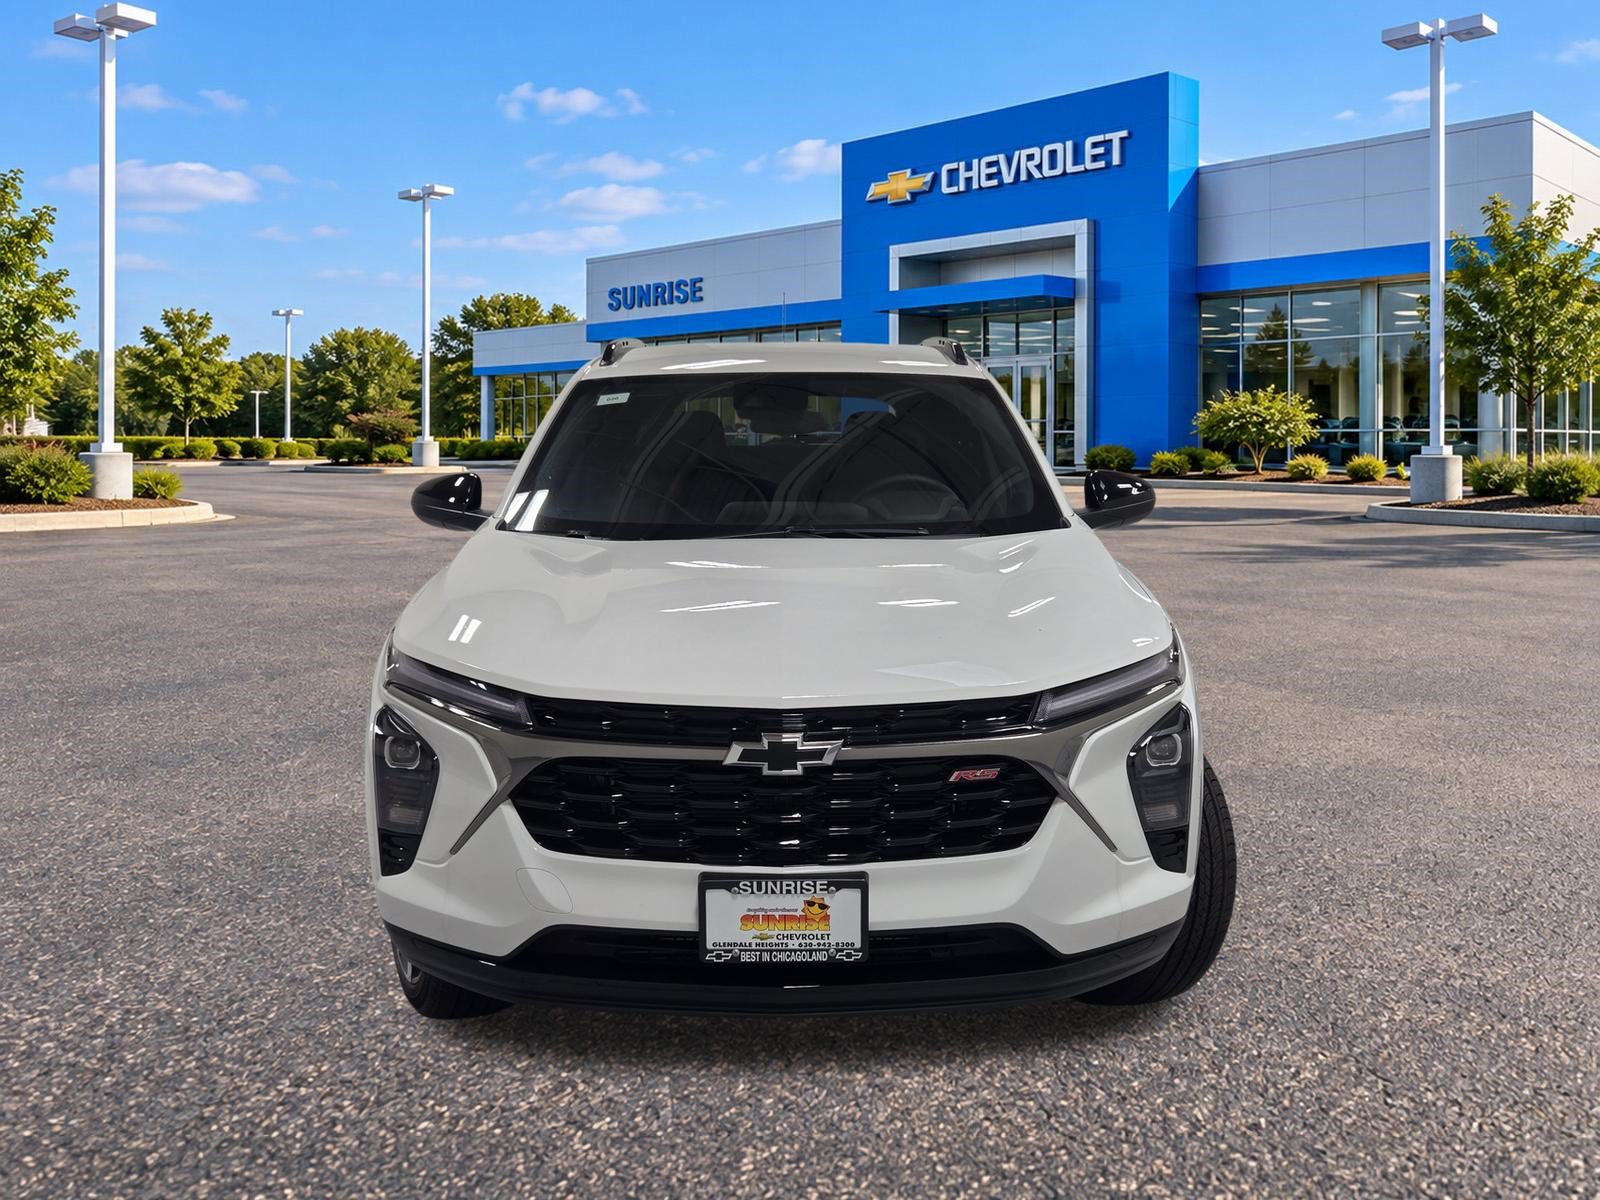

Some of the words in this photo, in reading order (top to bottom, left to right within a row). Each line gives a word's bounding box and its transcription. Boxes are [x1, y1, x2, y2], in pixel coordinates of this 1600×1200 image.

[940, 129, 1129, 194] CHEVROLET
[608, 277, 704, 312] SUNRISE
[949, 767, 1000, 782] RS
[739, 881, 828, 895] SUNRISE
[740, 914, 831, 931] SUNRISE
[776, 933, 831, 941] CHEVROLET
[740, 951, 761, 962] BEST
[762, 951, 771, 962] IN
[772, 951, 828, 962] CHICAGOLAND
